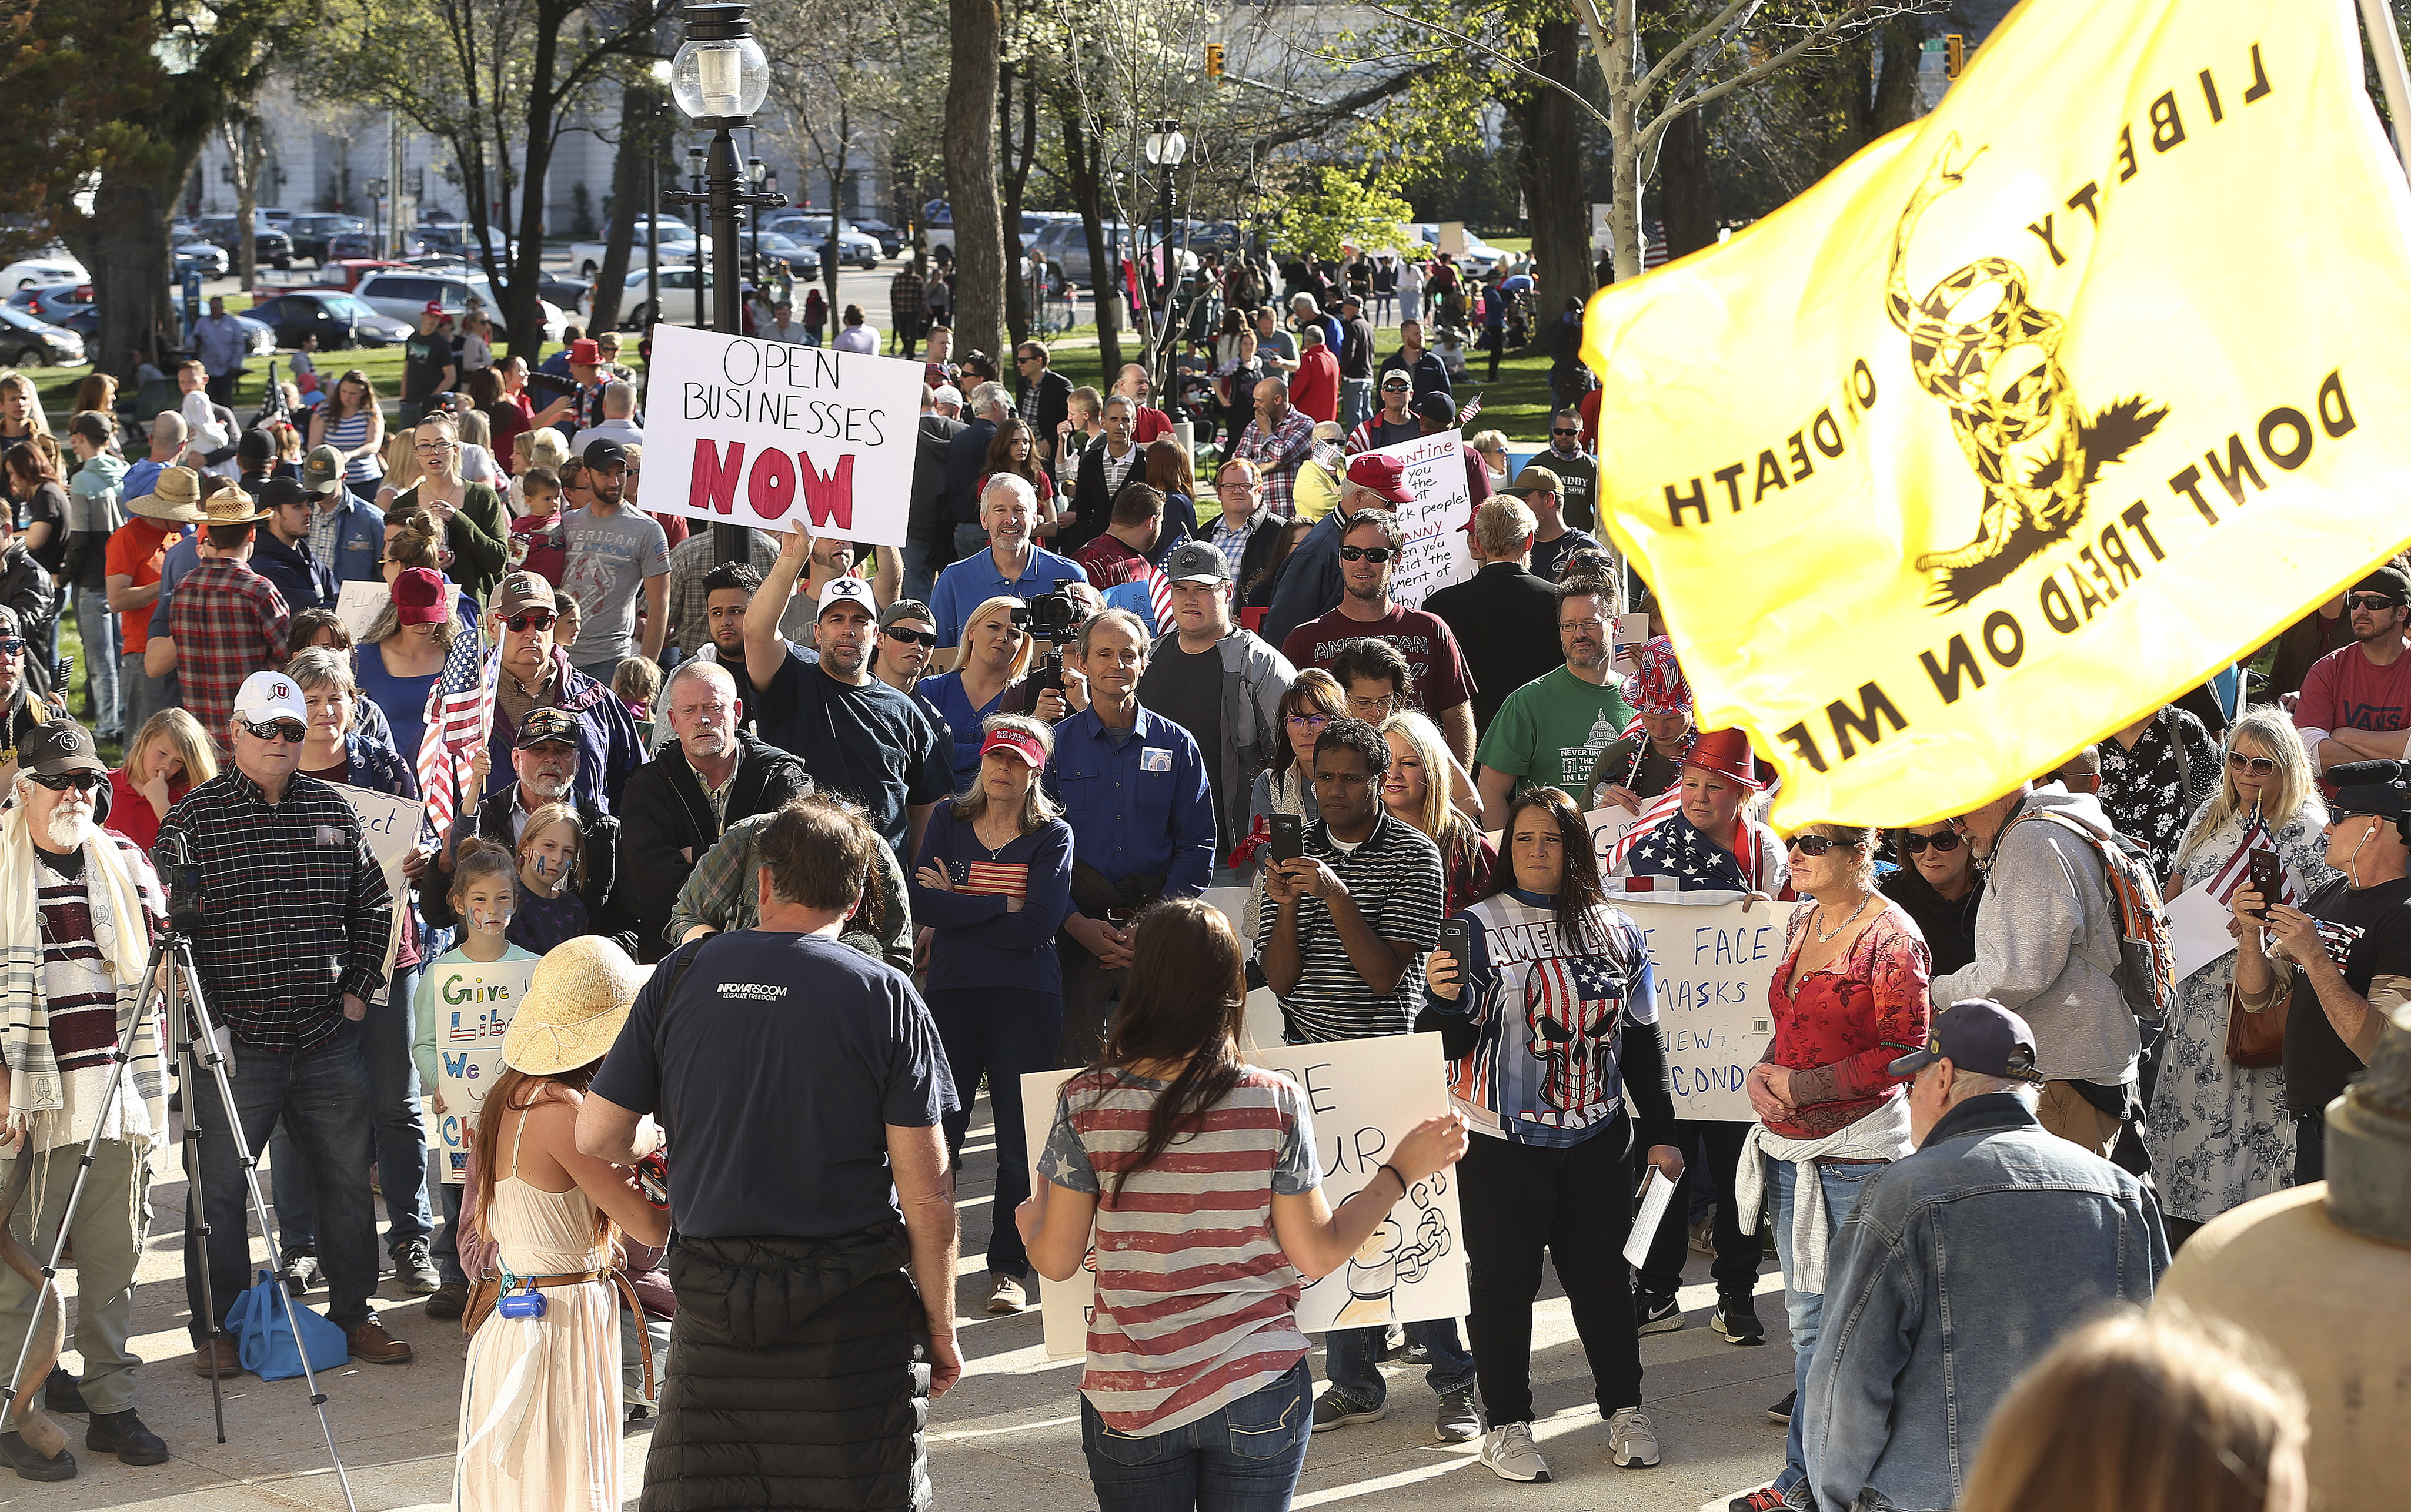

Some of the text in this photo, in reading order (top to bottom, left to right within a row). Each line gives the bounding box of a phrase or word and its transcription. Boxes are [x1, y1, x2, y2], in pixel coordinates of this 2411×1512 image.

[724, 339, 839, 389] OPEN
[684, 382, 886, 446] BUSINESSES
[689, 438, 856, 530] NOW
[1412, 478, 1437, 490] the
[1561, 476, 1588, 487] NDBY
[1398, 484, 1468, 523] ck people!
[567, 530, 637, 547] MERICAN
[1403, 520, 1442, 544] ANNY
[1402, 541, 1445, 558] en you
[1428, 551, 1452, 564] the
[1393, 570, 1430, 590] ment
[1436, 563, 1451, 577] of
[342, 590, 369, 608] ALL
[792, 620, 816, 641] UNIT
[527, 710, 549, 724] DESERT
[2343, 700, 2402, 731] VANS
[1644, 926, 1772, 966] E FACE
[443, 974, 510, 1005] Give
[748, 993, 776, 1001] FREEDOM
[449, 1009, 513, 1042] Lib
[442, 1052, 480, 1079] We
[1672, 1065, 1745, 1097] COND
[443, 1115, 476, 1149] Ch
[1315, 1127, 1386, 1178] UR
